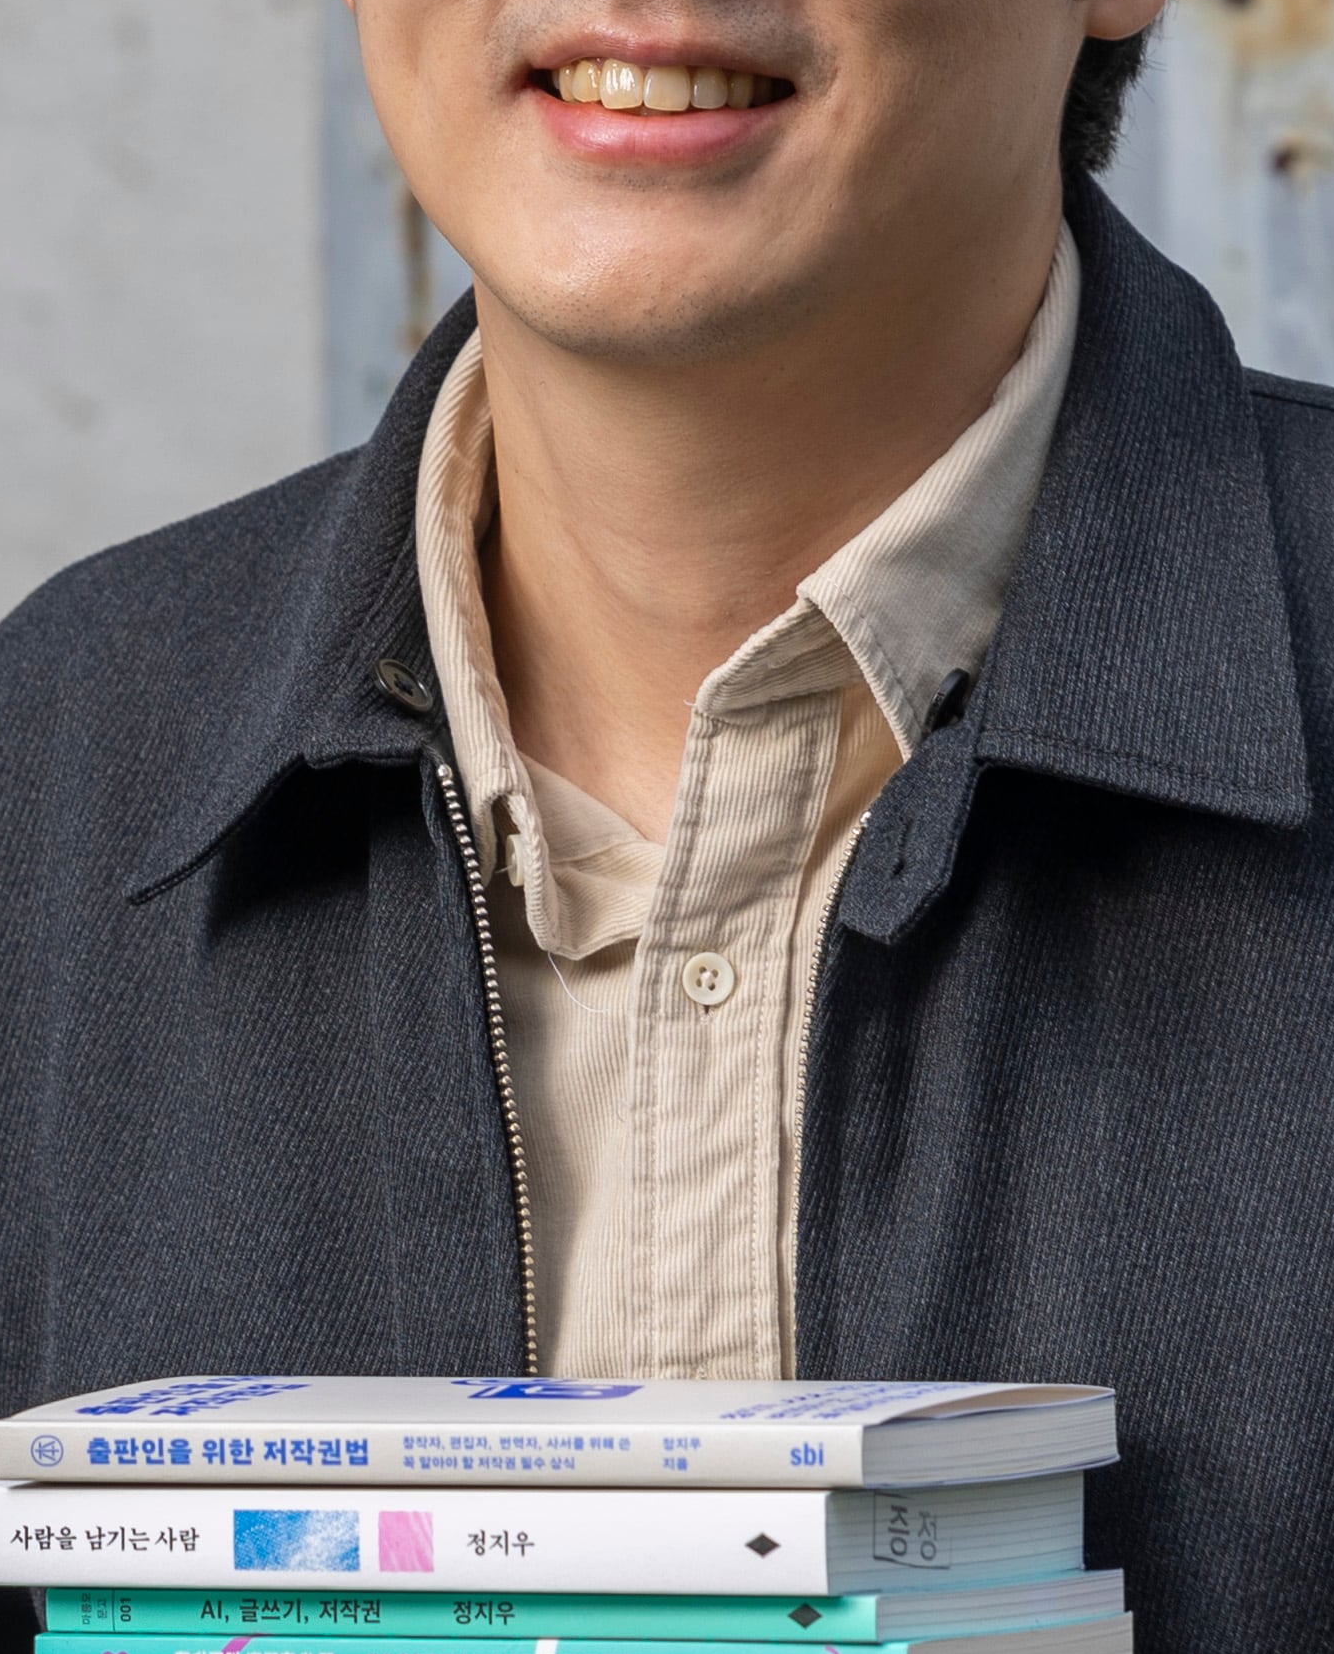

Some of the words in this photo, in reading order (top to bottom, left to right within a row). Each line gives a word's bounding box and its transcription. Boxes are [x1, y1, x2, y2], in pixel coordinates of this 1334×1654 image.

[86, 1436, 193, 1466] 출판인을
[201, 1437, 254, 1466] 위한
[263, 1437, 369, 1467] 저작권법
[547, 1436, 584, 1451] 사서를
[589, 1437, 614, 1450] 위해
[663, 1437, 701, 1451] 정지우
[790, 1443, 825, 1467] sbi
[419, 1456, 458, 1470] 알아야
[462, 1456, 473, 1470] 할
[478, 1456, 516, 1470] 저작권
[521, 1456, 545, 1470] 필수
[550, 1457, 575, 1470] 상식
[663, 1457, 688, 1471] 지음
[10, 1525, 77, 1551] 사람을
[85, 1526, 149, 1552] 남기는
[155, 1526, 200, 1552] 사람
[467, 1530, 535, 1557] 정지우
[120, 1597, 133, 1622] 001
[200, 1599, 229, 1623] AI,
[239, 1599, 309, 1624] 글쓰기,
[319, 1599, 382, 1625] 저작권
[453, 1600, 515, 1625] 정지우
